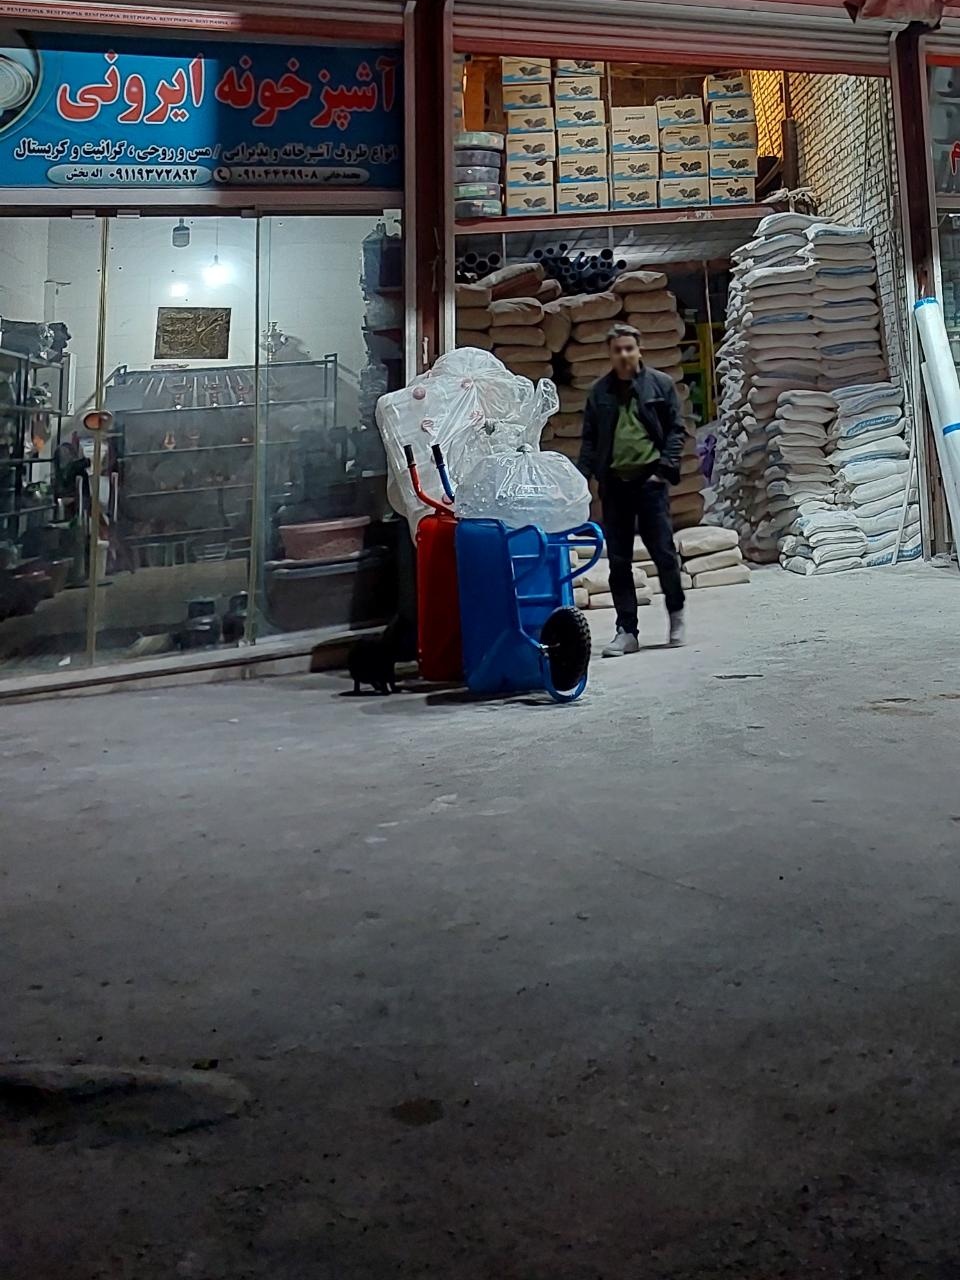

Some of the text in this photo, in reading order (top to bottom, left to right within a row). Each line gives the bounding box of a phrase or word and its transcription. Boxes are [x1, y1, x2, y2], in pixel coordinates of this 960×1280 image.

[56, 50, 400, 130] آشپزخونه ایرونی
[14, 138, 69, 161] کریستال
[81, 140, 127, 161] گرانیت
[187, 145, 212, 162] مس
[333, 143, 368, 164] ظروف
[371, 144, 397, 163] انواع
